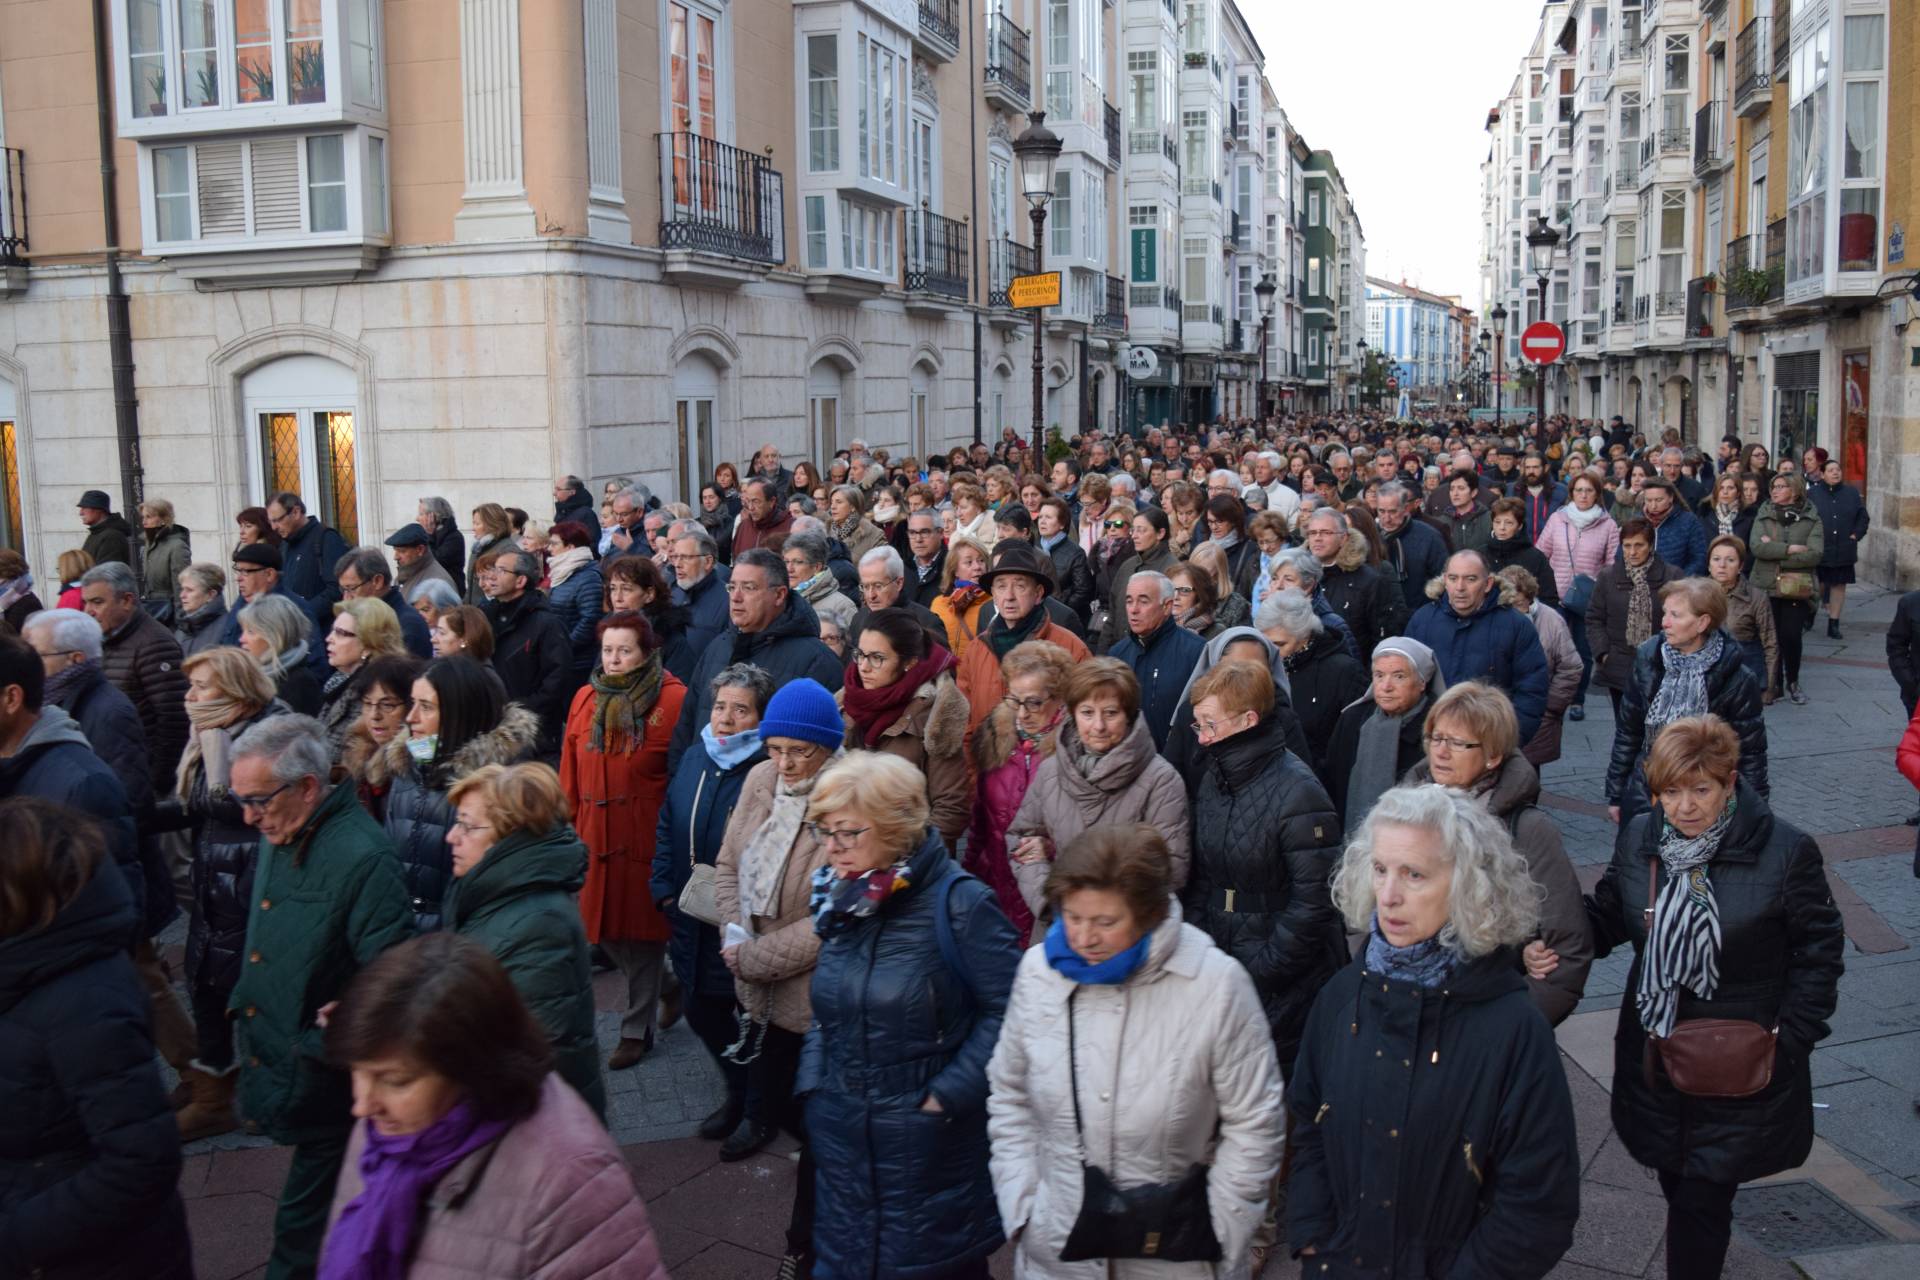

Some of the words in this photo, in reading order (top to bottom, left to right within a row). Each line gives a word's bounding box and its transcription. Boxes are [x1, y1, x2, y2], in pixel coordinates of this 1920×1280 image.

[1017, 274, 1048, 286] ALBERGUE
[1049, 274, 1058, 283] DE
[1018, 287, 1057, 297] PEREGRINOS
